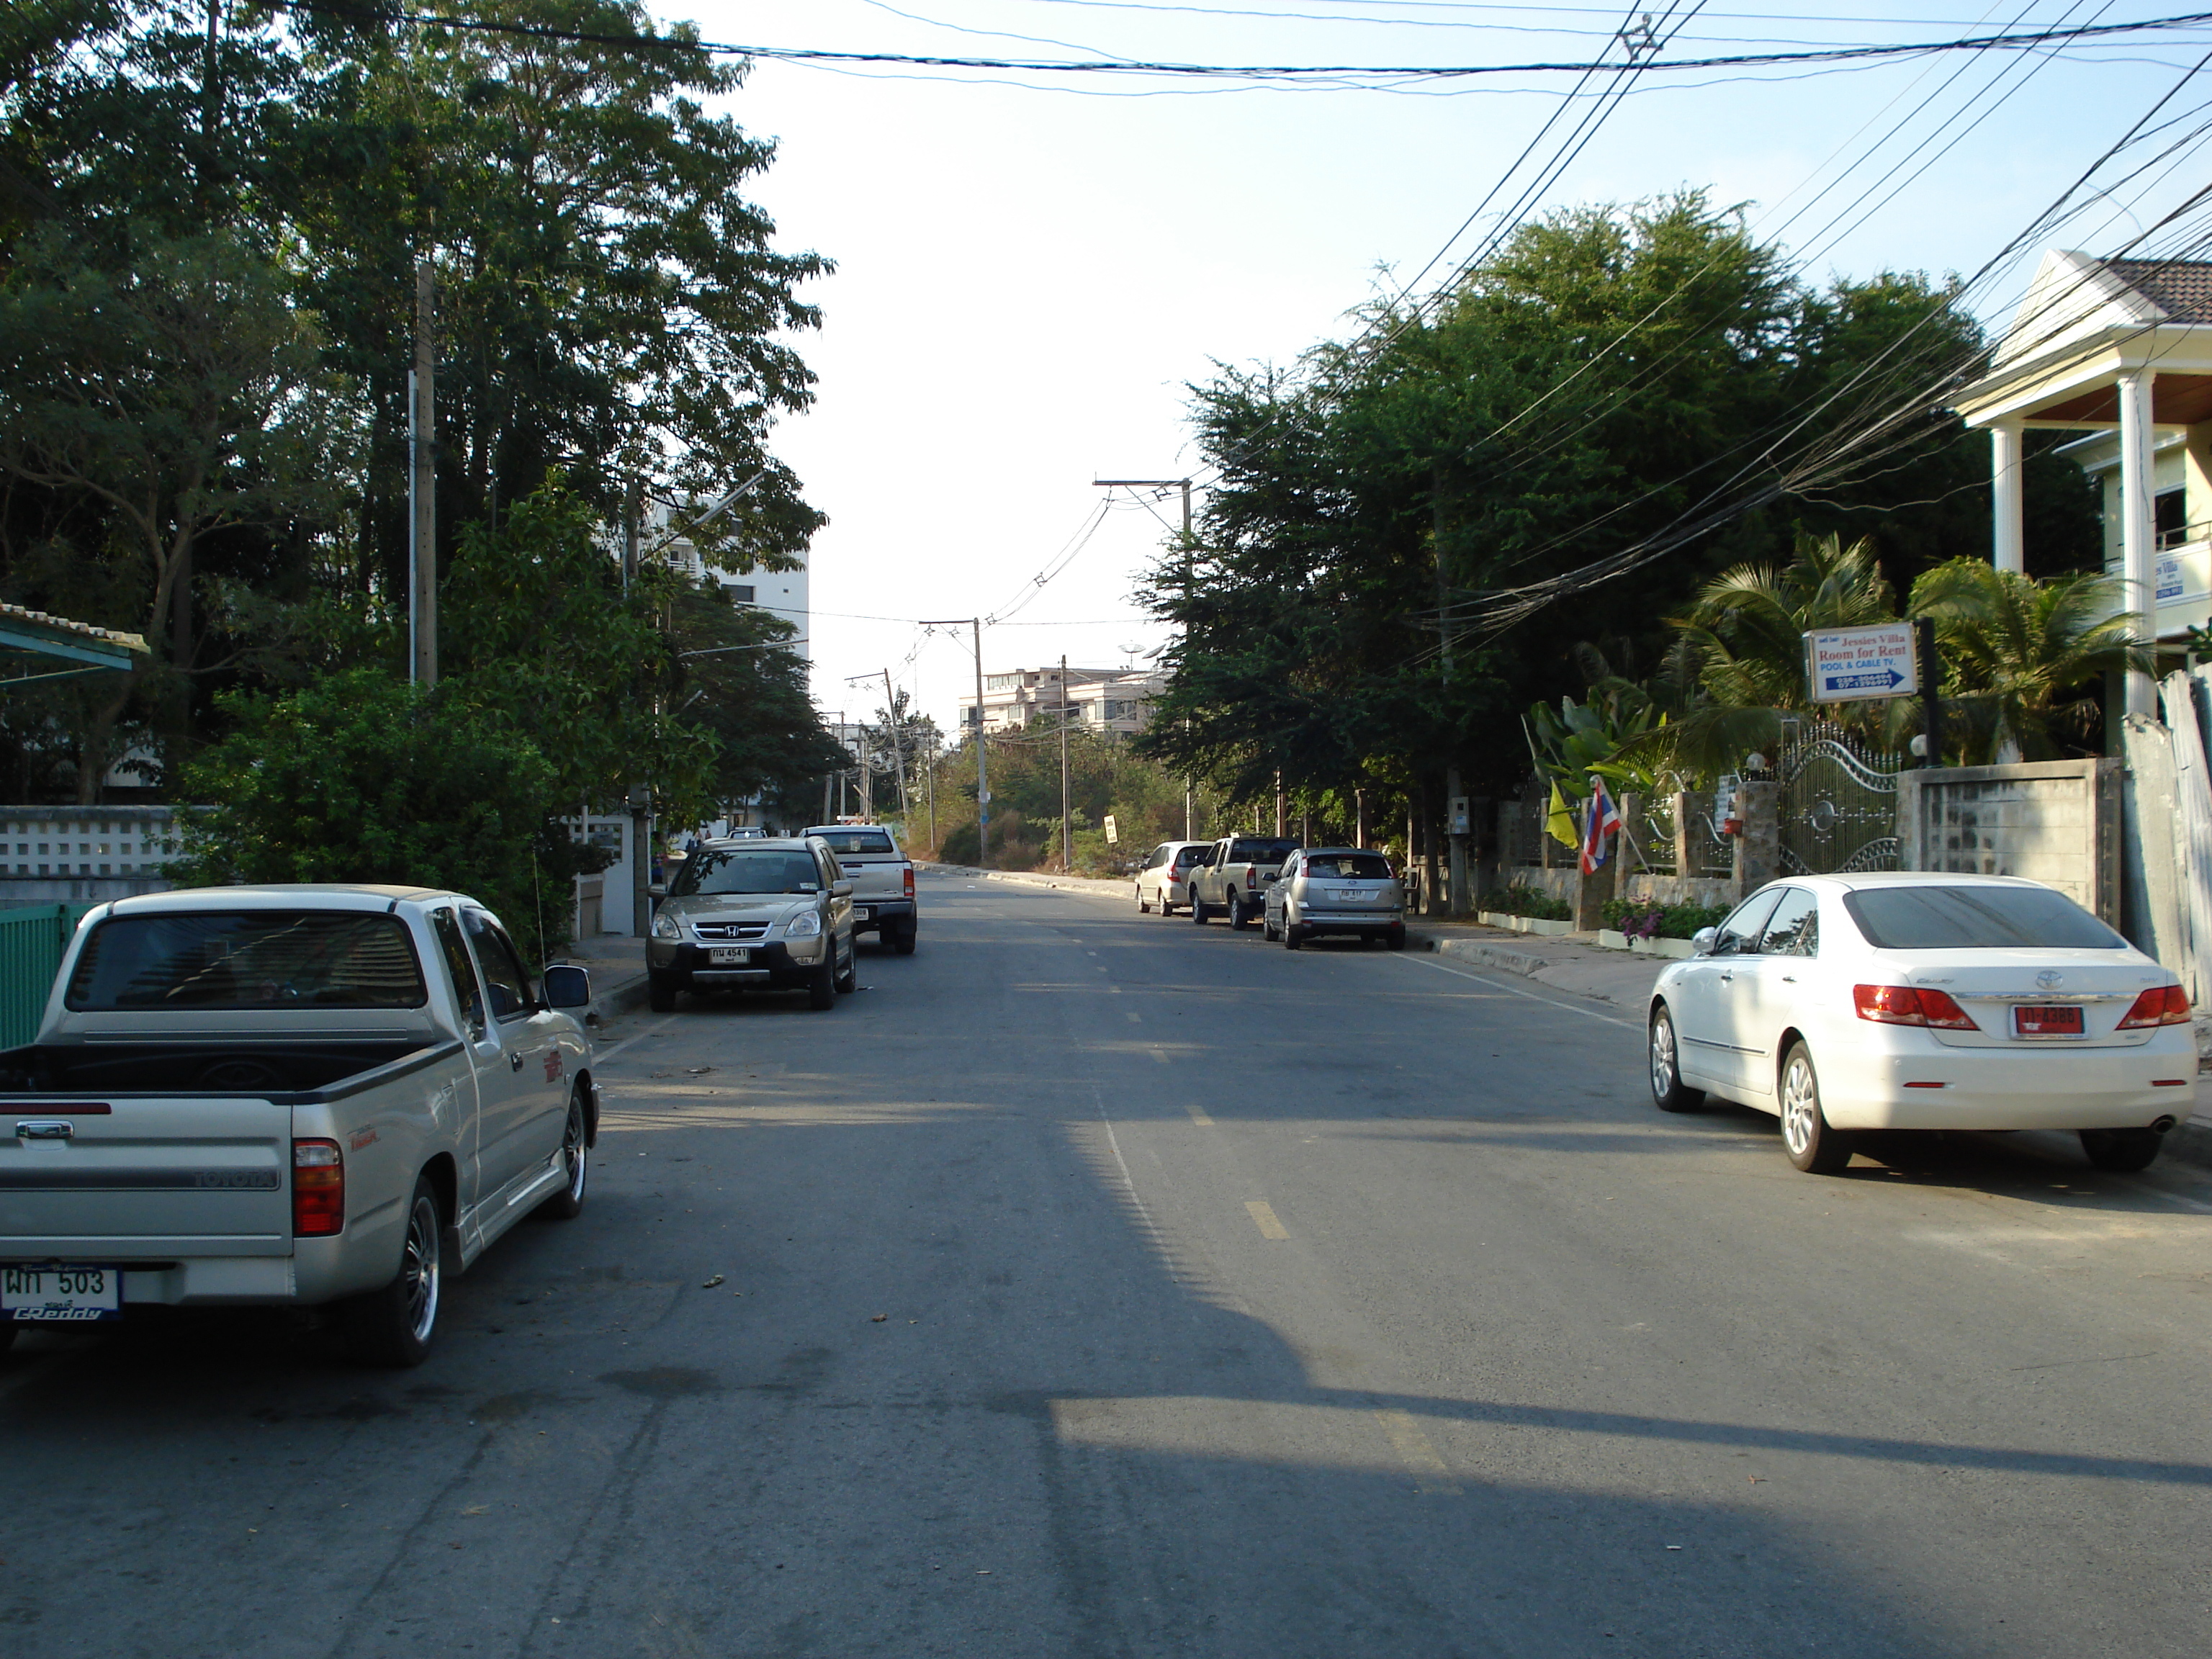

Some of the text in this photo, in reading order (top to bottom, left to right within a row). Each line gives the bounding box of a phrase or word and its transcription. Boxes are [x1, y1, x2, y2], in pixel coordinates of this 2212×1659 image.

[1842, 634, 1905, 647] Jessies Villa
[1820, 645, 1906, 661] Room for Rent
[1856, 659, 1881, 668] CABLE
[194, 1172, 274, 1187] TOYOTA
[59, 1270, 104, 1294] 503
